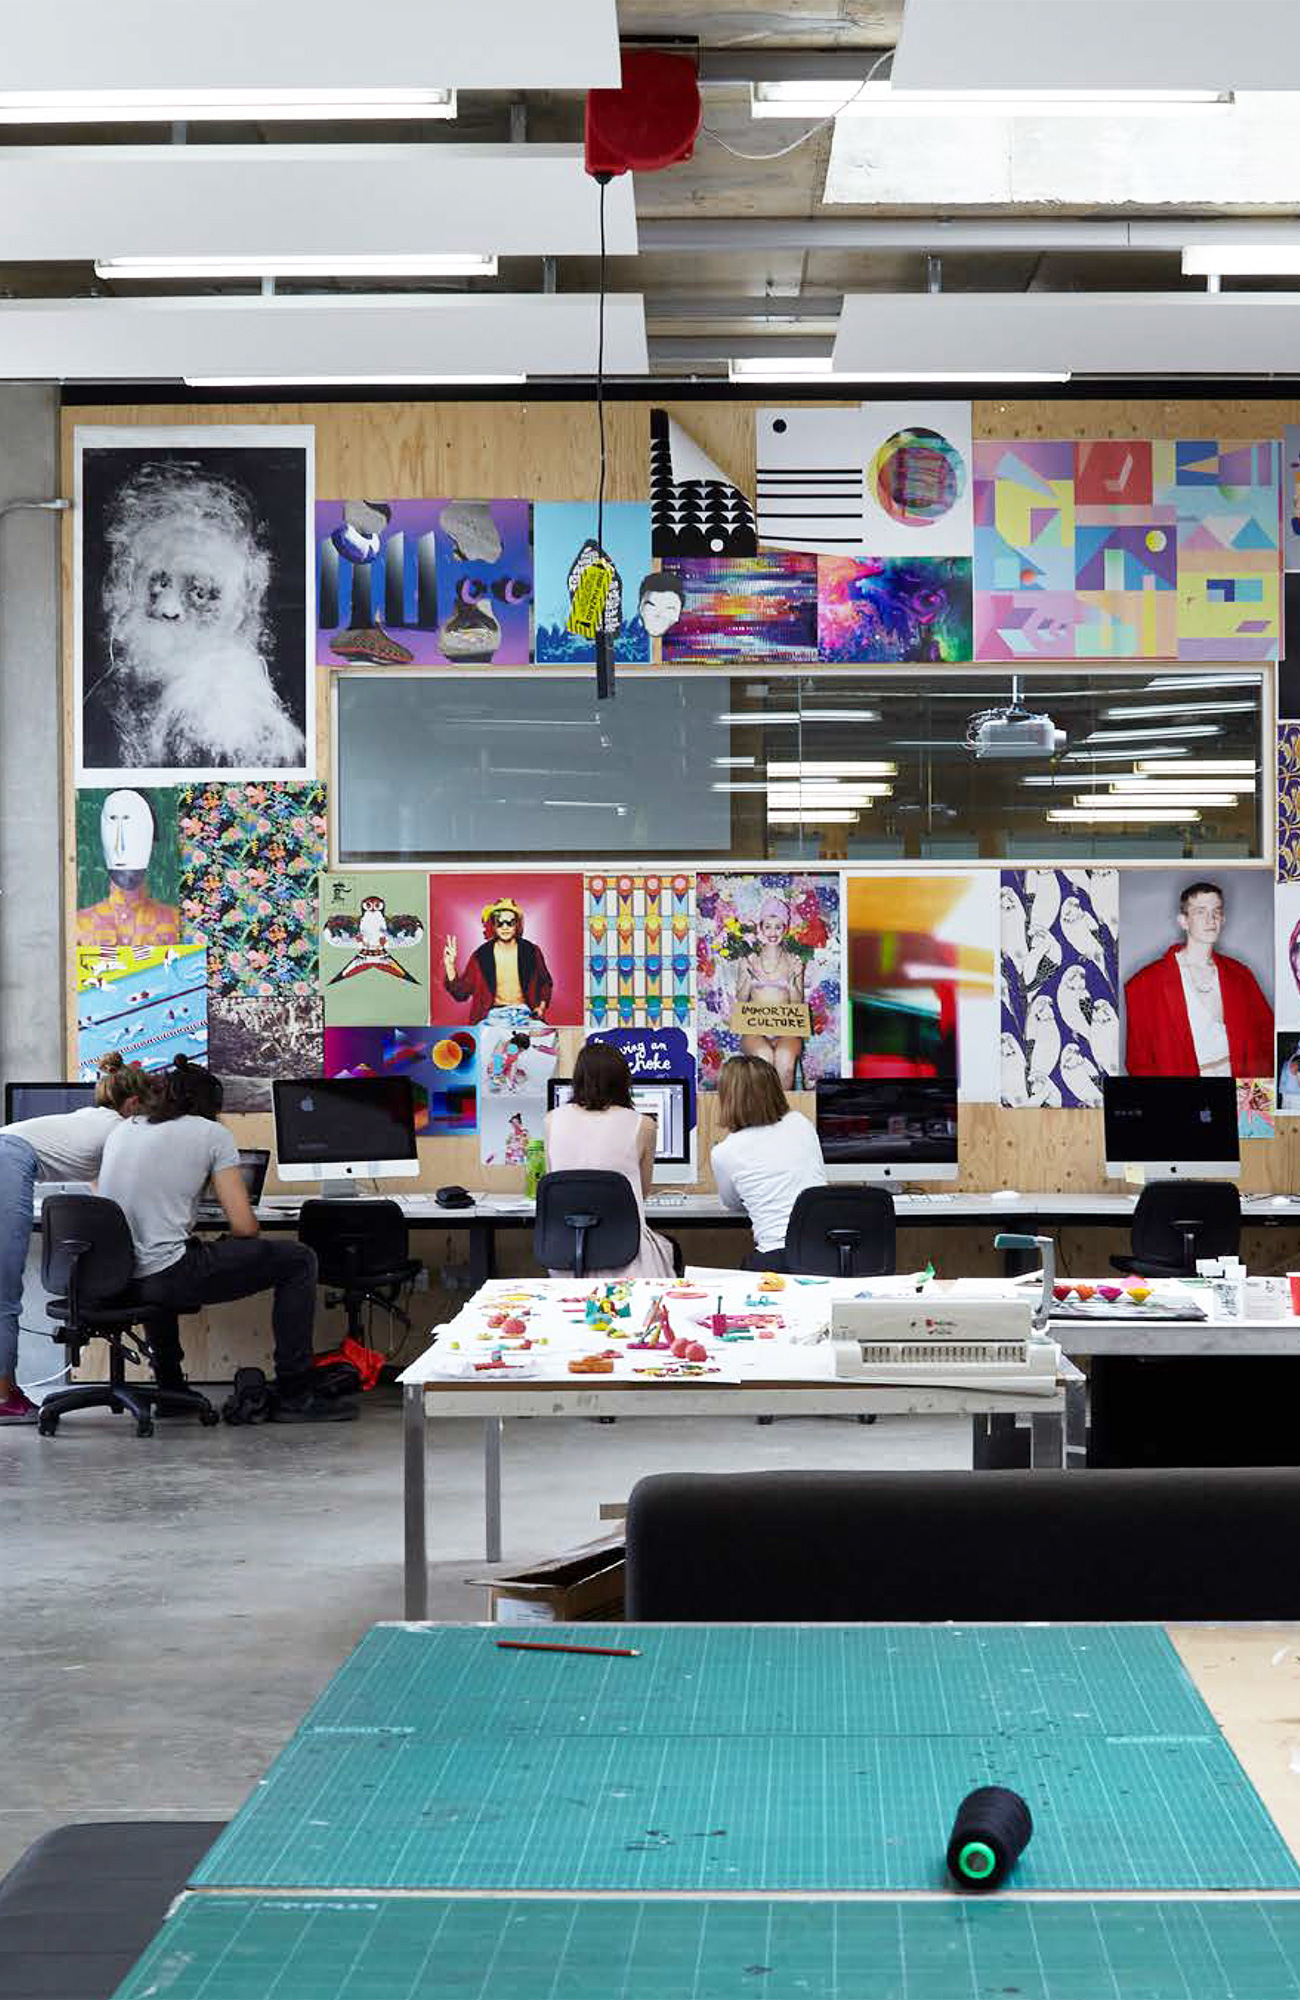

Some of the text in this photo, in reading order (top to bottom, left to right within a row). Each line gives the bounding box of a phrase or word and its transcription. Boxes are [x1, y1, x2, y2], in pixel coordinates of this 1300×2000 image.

[742, 1006, 804, 1017] IMMORTAL
[747, 1018, 805, 1028] CULTURE
[651, 1042, 667, 1051] an
